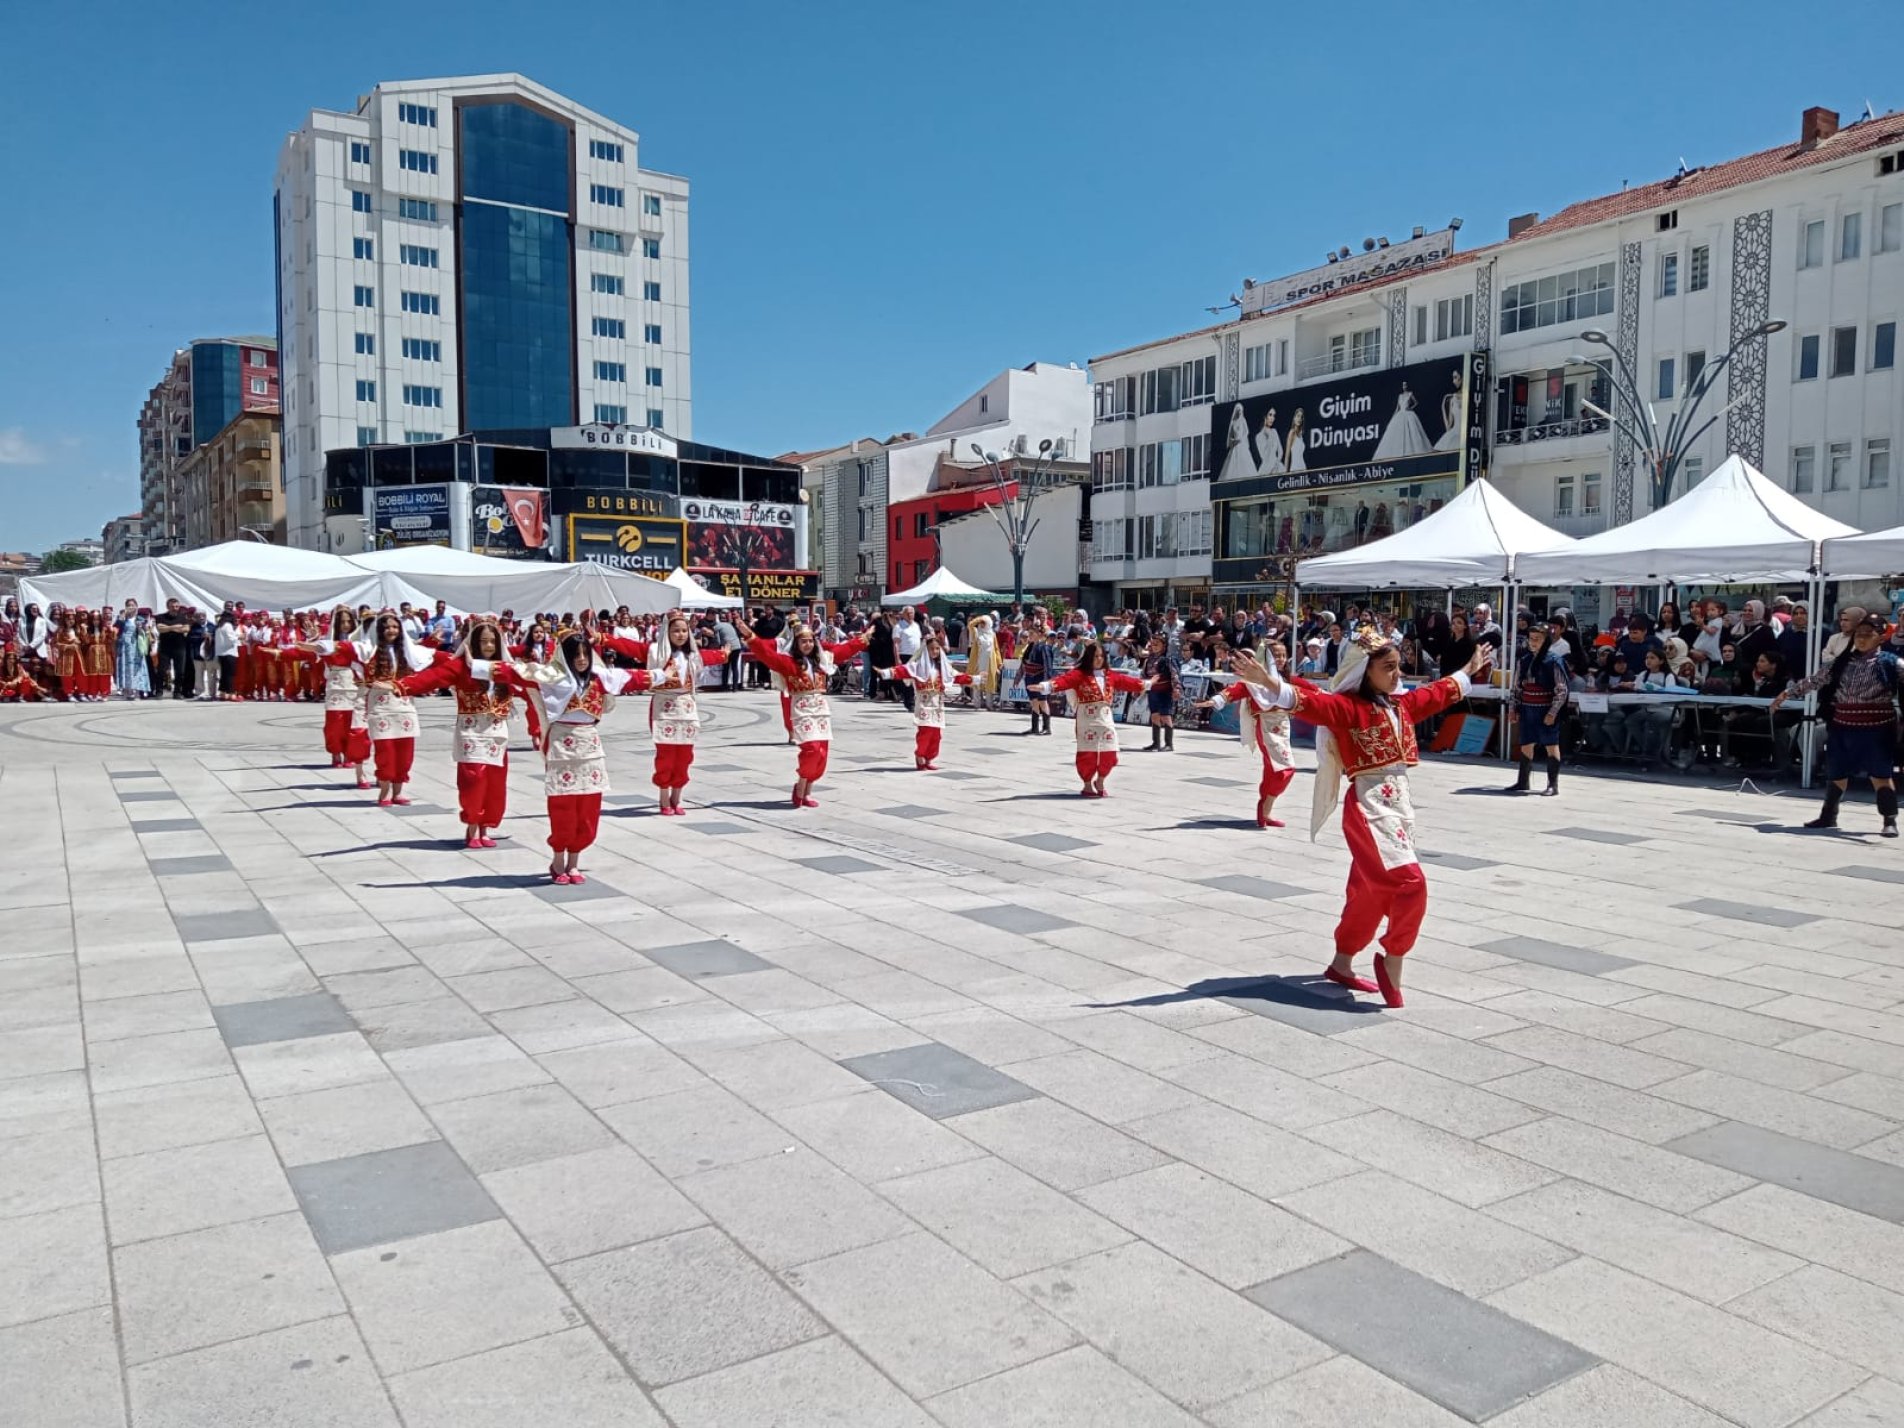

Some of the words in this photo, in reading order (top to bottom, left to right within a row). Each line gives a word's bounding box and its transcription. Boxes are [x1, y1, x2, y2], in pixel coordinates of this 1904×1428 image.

[1286, 280, 1335, 301] SPOR
[1319, 392, 1372, 420] Giyim
[1310, 423, 1379, 449] Dünyası
[1277, 474, 1312, 490] Gelinlik
[1363, 465, 1395, 480] Abiye
[415, 493, 446, 504] ROYAL
[585, 553, 673, 570] TURKCELL
[751, 585, 801, 598] DÖNER
